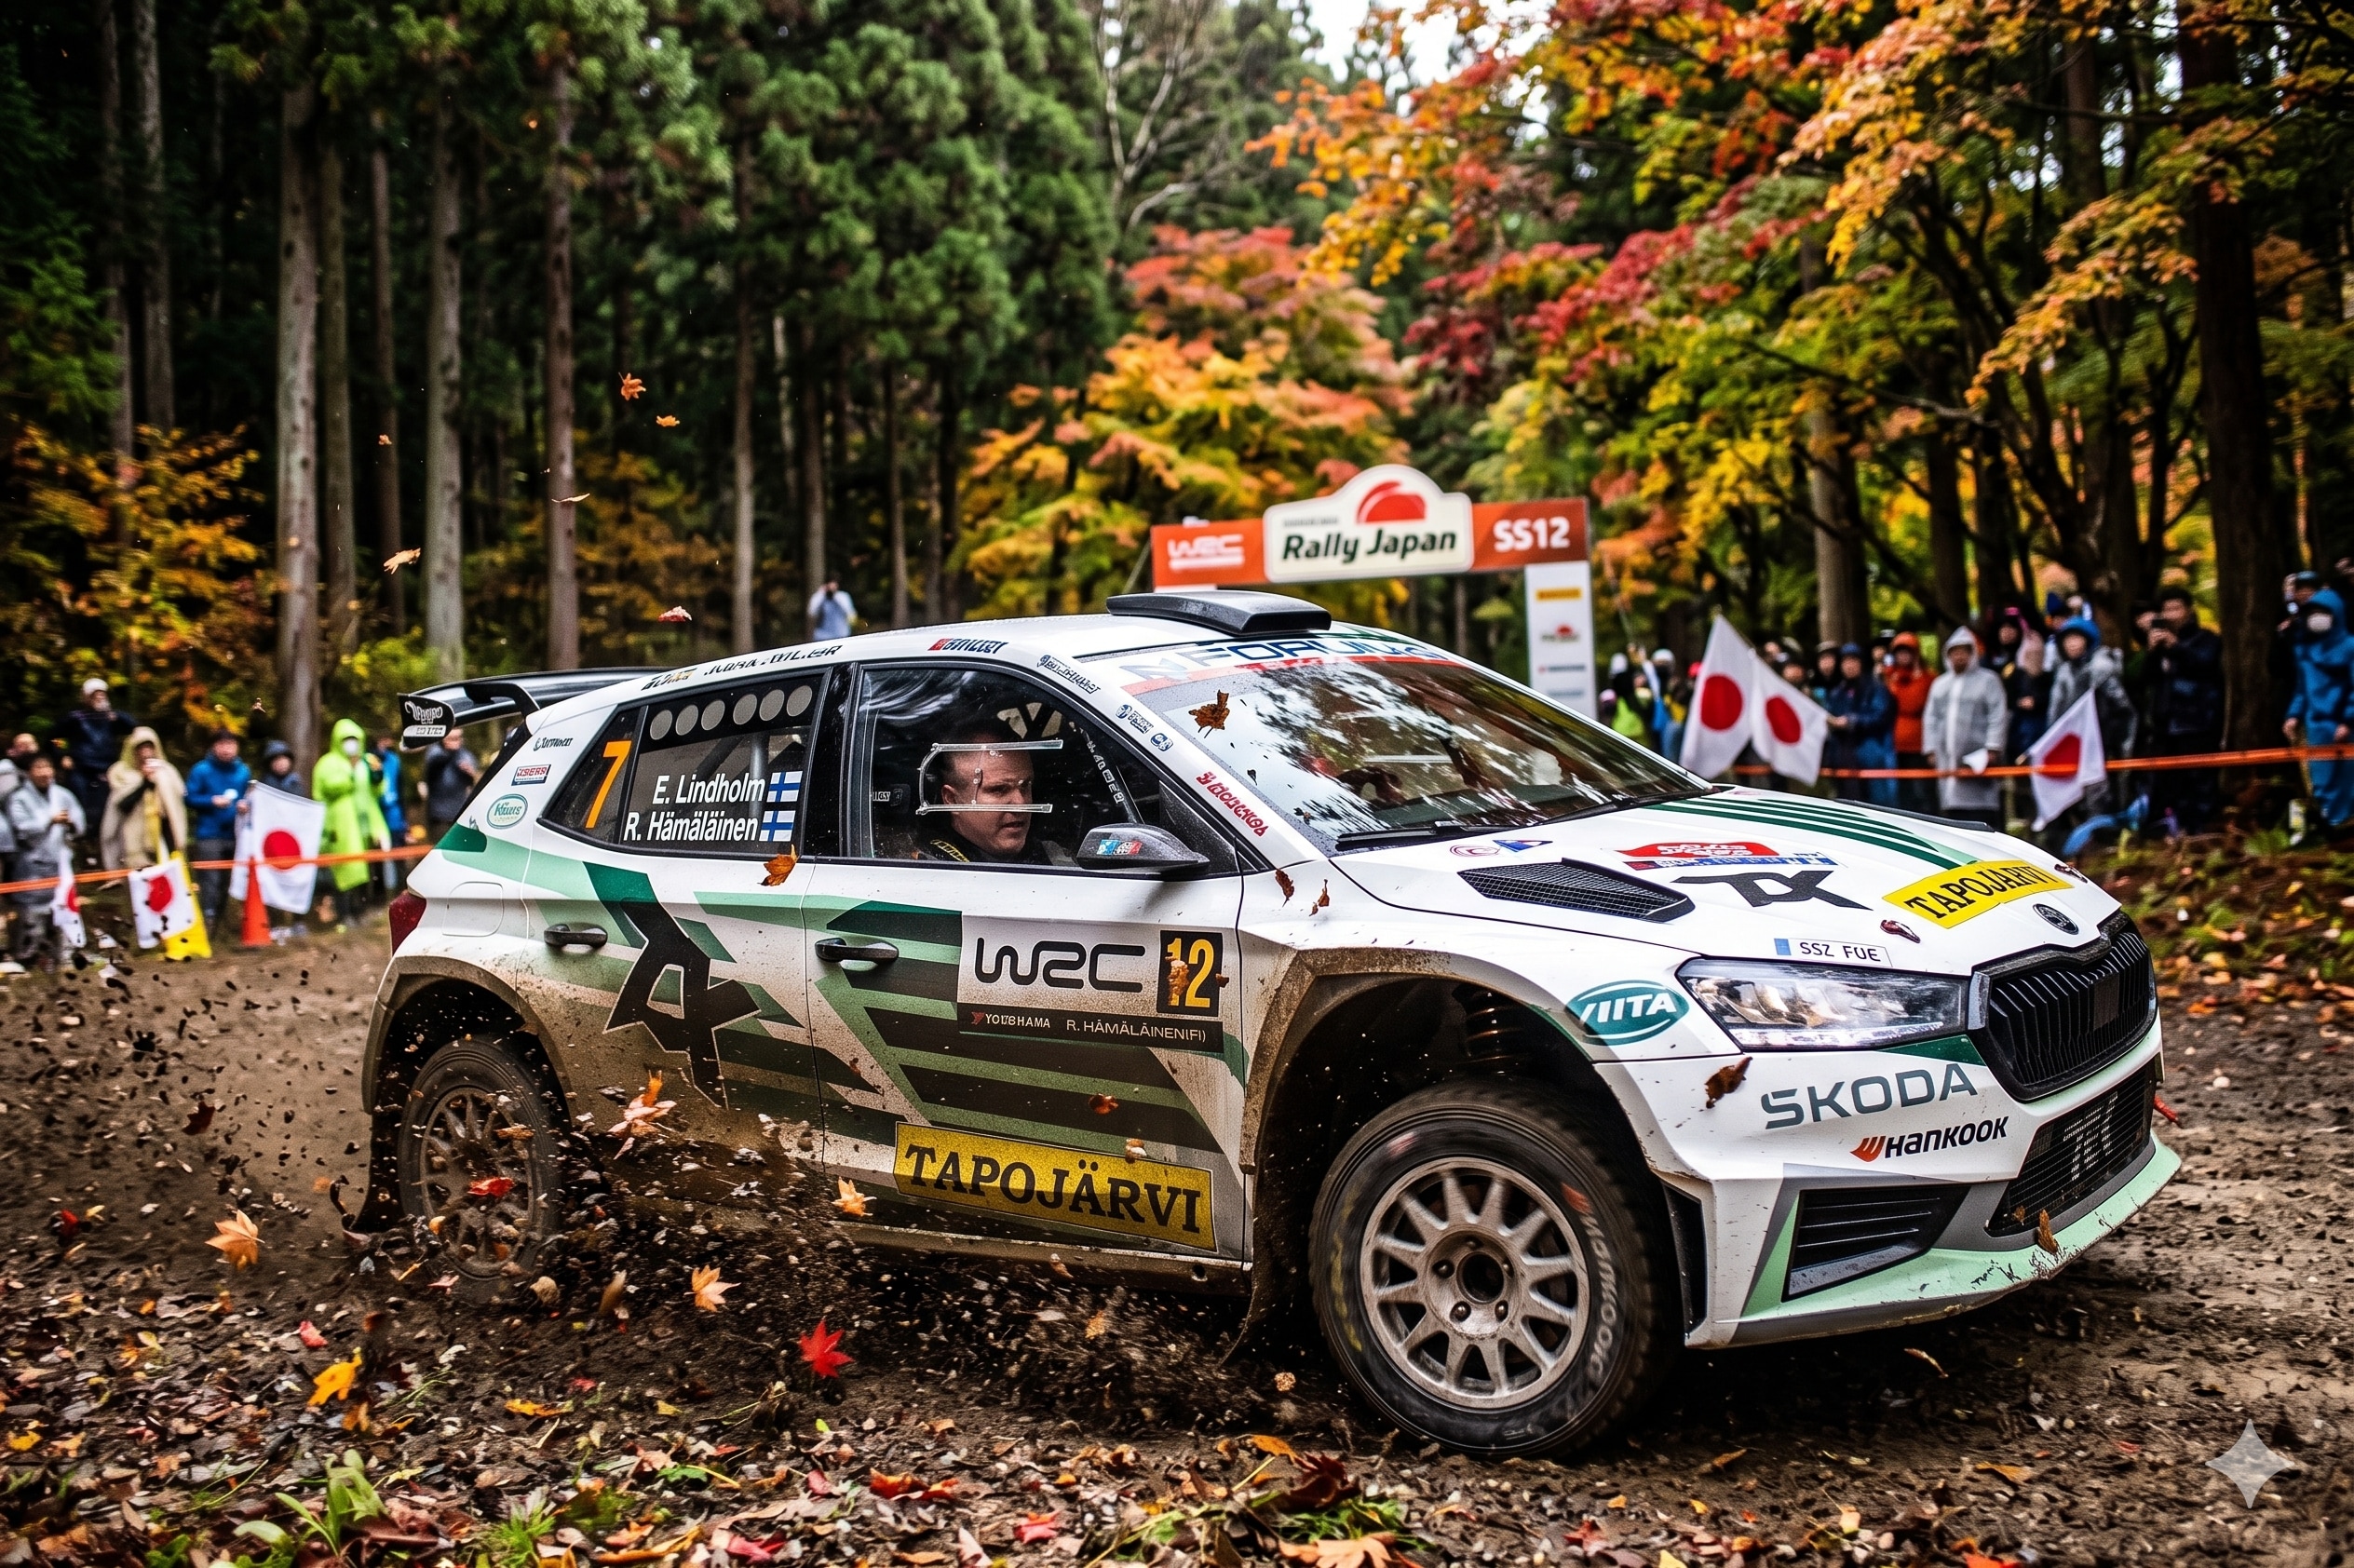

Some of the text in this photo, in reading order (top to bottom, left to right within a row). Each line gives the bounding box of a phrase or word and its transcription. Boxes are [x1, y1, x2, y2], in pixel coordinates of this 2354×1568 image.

[1283, 527, 1457, 564] Rally Japan
[1493, 516, 1570, 553] SS12
[585, 740, 632, 829] 7
[652, 772, 766, 804] E. Lindholm
[623, 811, 759, 842] R. Hämäläinen
[975, 937, 1146, 994] WRC
[1799, 941, 1881, 962] SSZ FUE
[1164, 937, 1216, 1009] 12
[1066, 1019, 1081, 1032] R.
[1760, 1062, 1979, 1129] SKODA
[904, 1143, 1201, 1235] TAPOJÄRVI
